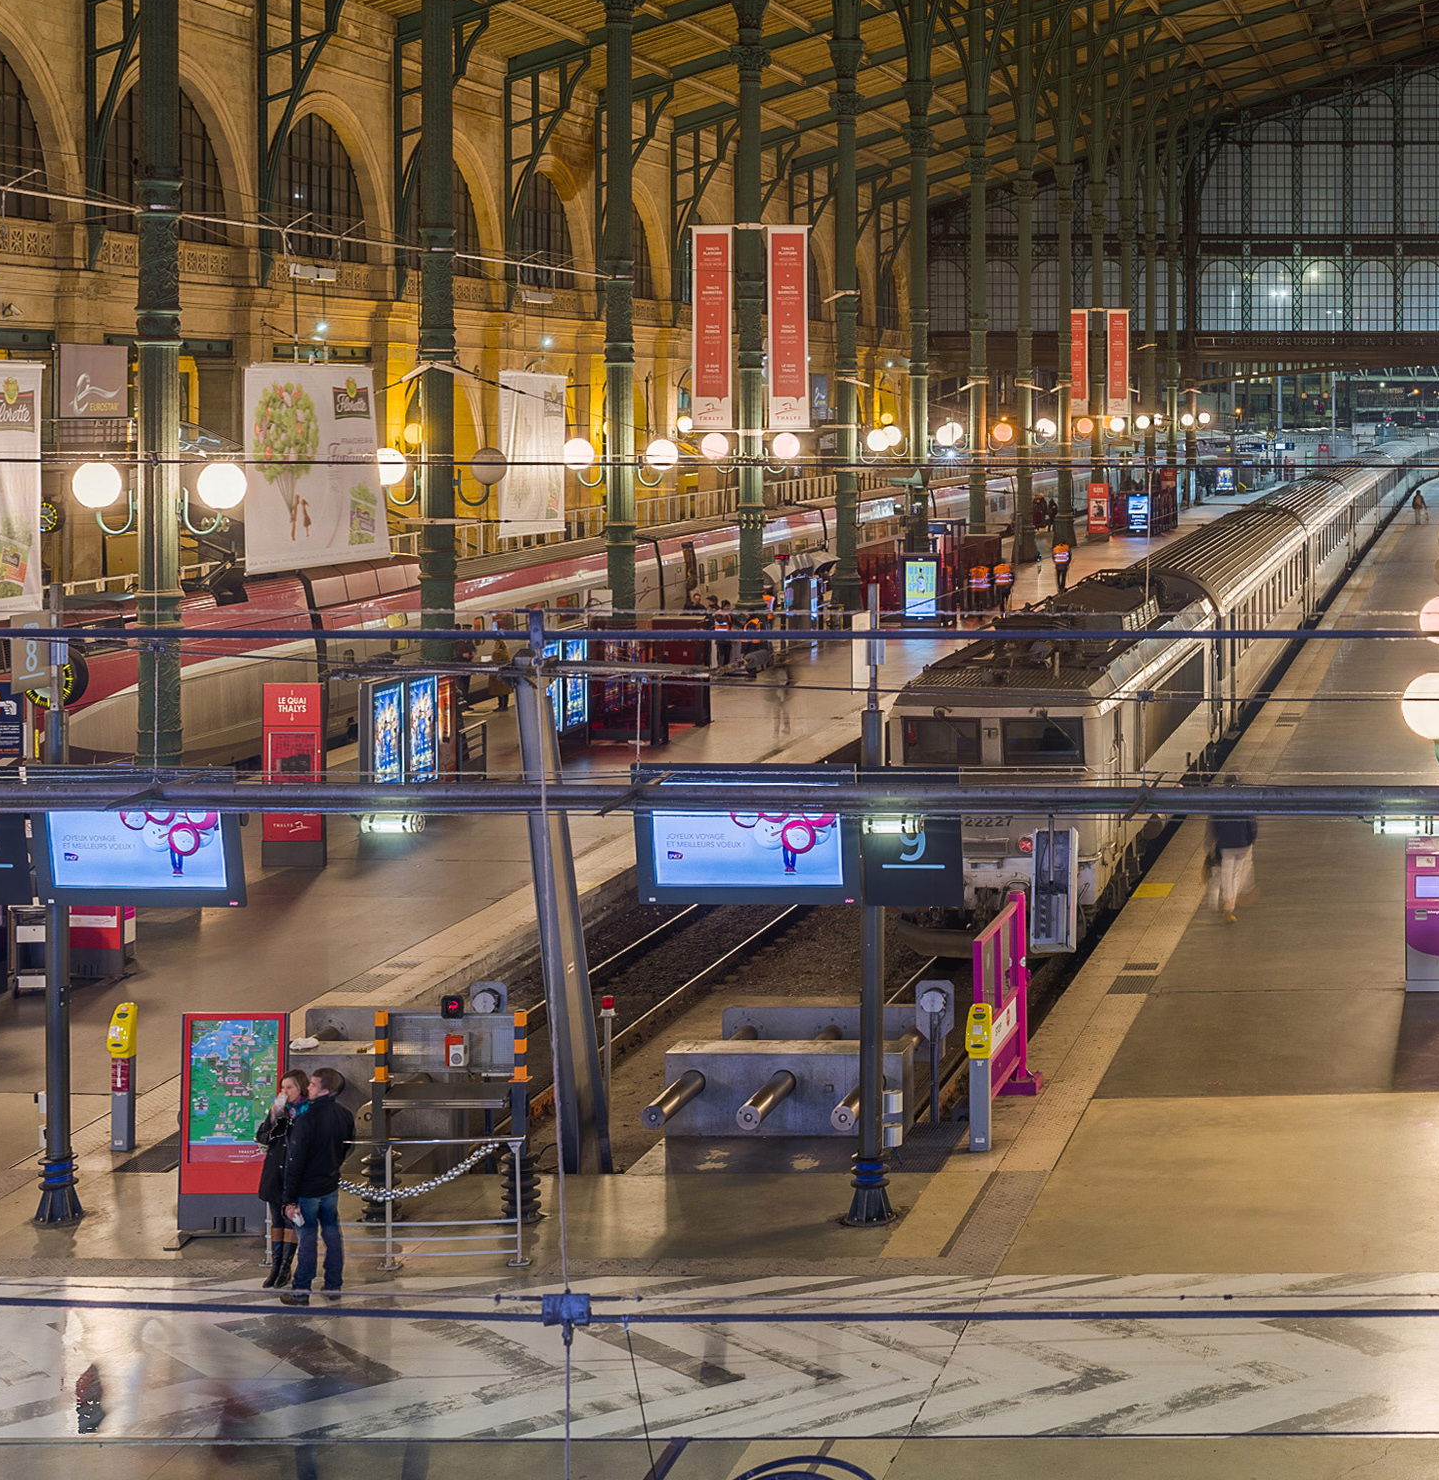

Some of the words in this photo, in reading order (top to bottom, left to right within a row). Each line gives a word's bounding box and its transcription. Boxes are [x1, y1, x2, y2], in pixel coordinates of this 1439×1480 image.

[90, 402, 118, 411] EUROSTAR
[26, 640, 38, 672] 8
[278, 705, 306, 713] THALYS
[964, 816, 1013, 827] 22227
[899, 831, 927, 862] 9
